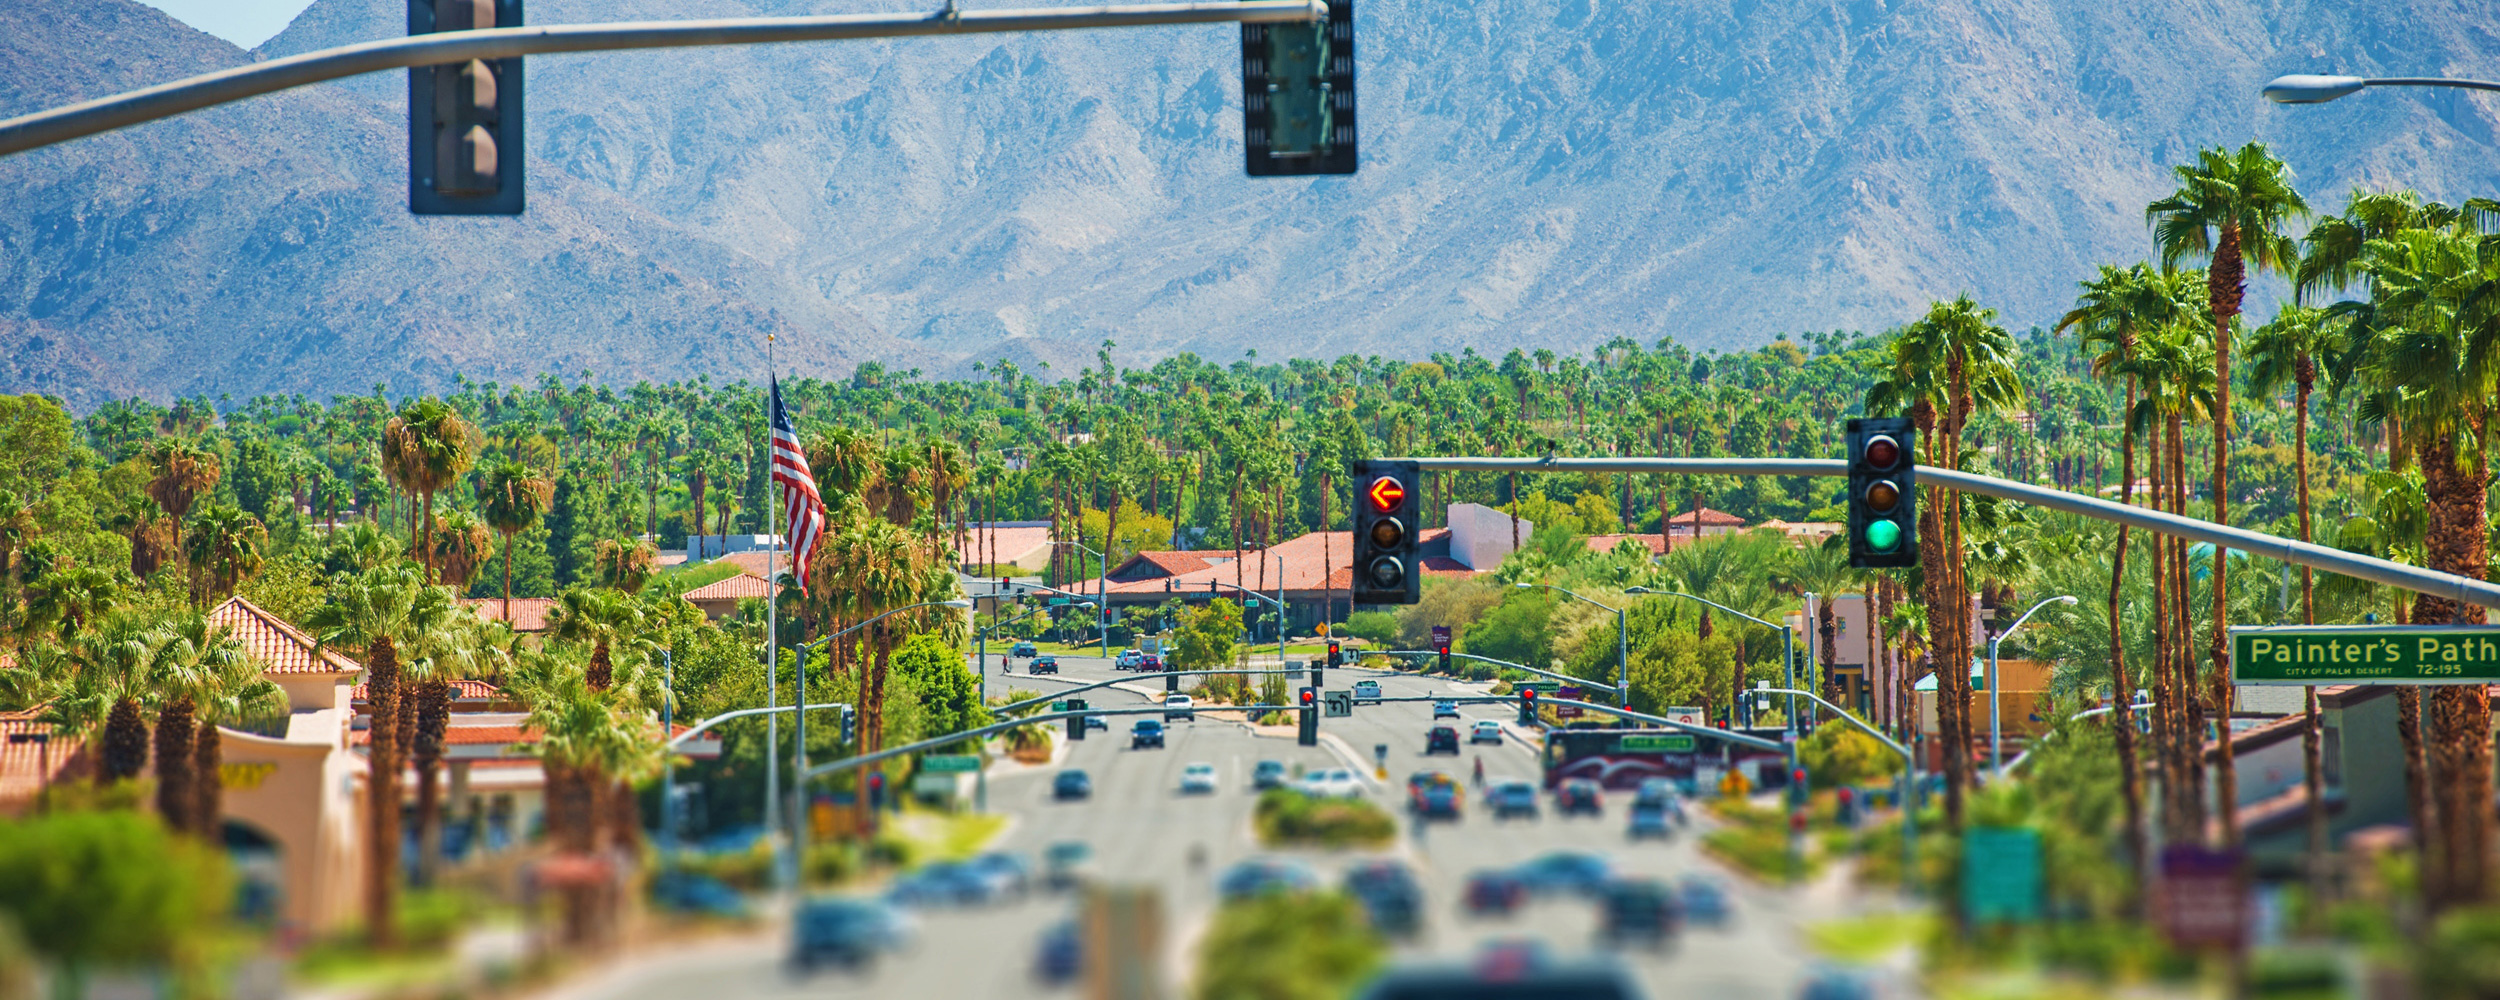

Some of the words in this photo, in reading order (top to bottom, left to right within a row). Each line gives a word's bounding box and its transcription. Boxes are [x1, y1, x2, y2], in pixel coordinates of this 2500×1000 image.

[2252, 638, 2401, 663] Painter's
[2418, 637, 2497, 662] Path
[2286, 667, 2308, 676] CITY
[2310, 667, 2322, 675] OF
[2325, 667, 2351, 675] PALM
[2355, 667, 2393, 675] DESERT
[2416, 664, 2462, 675] 72-195
